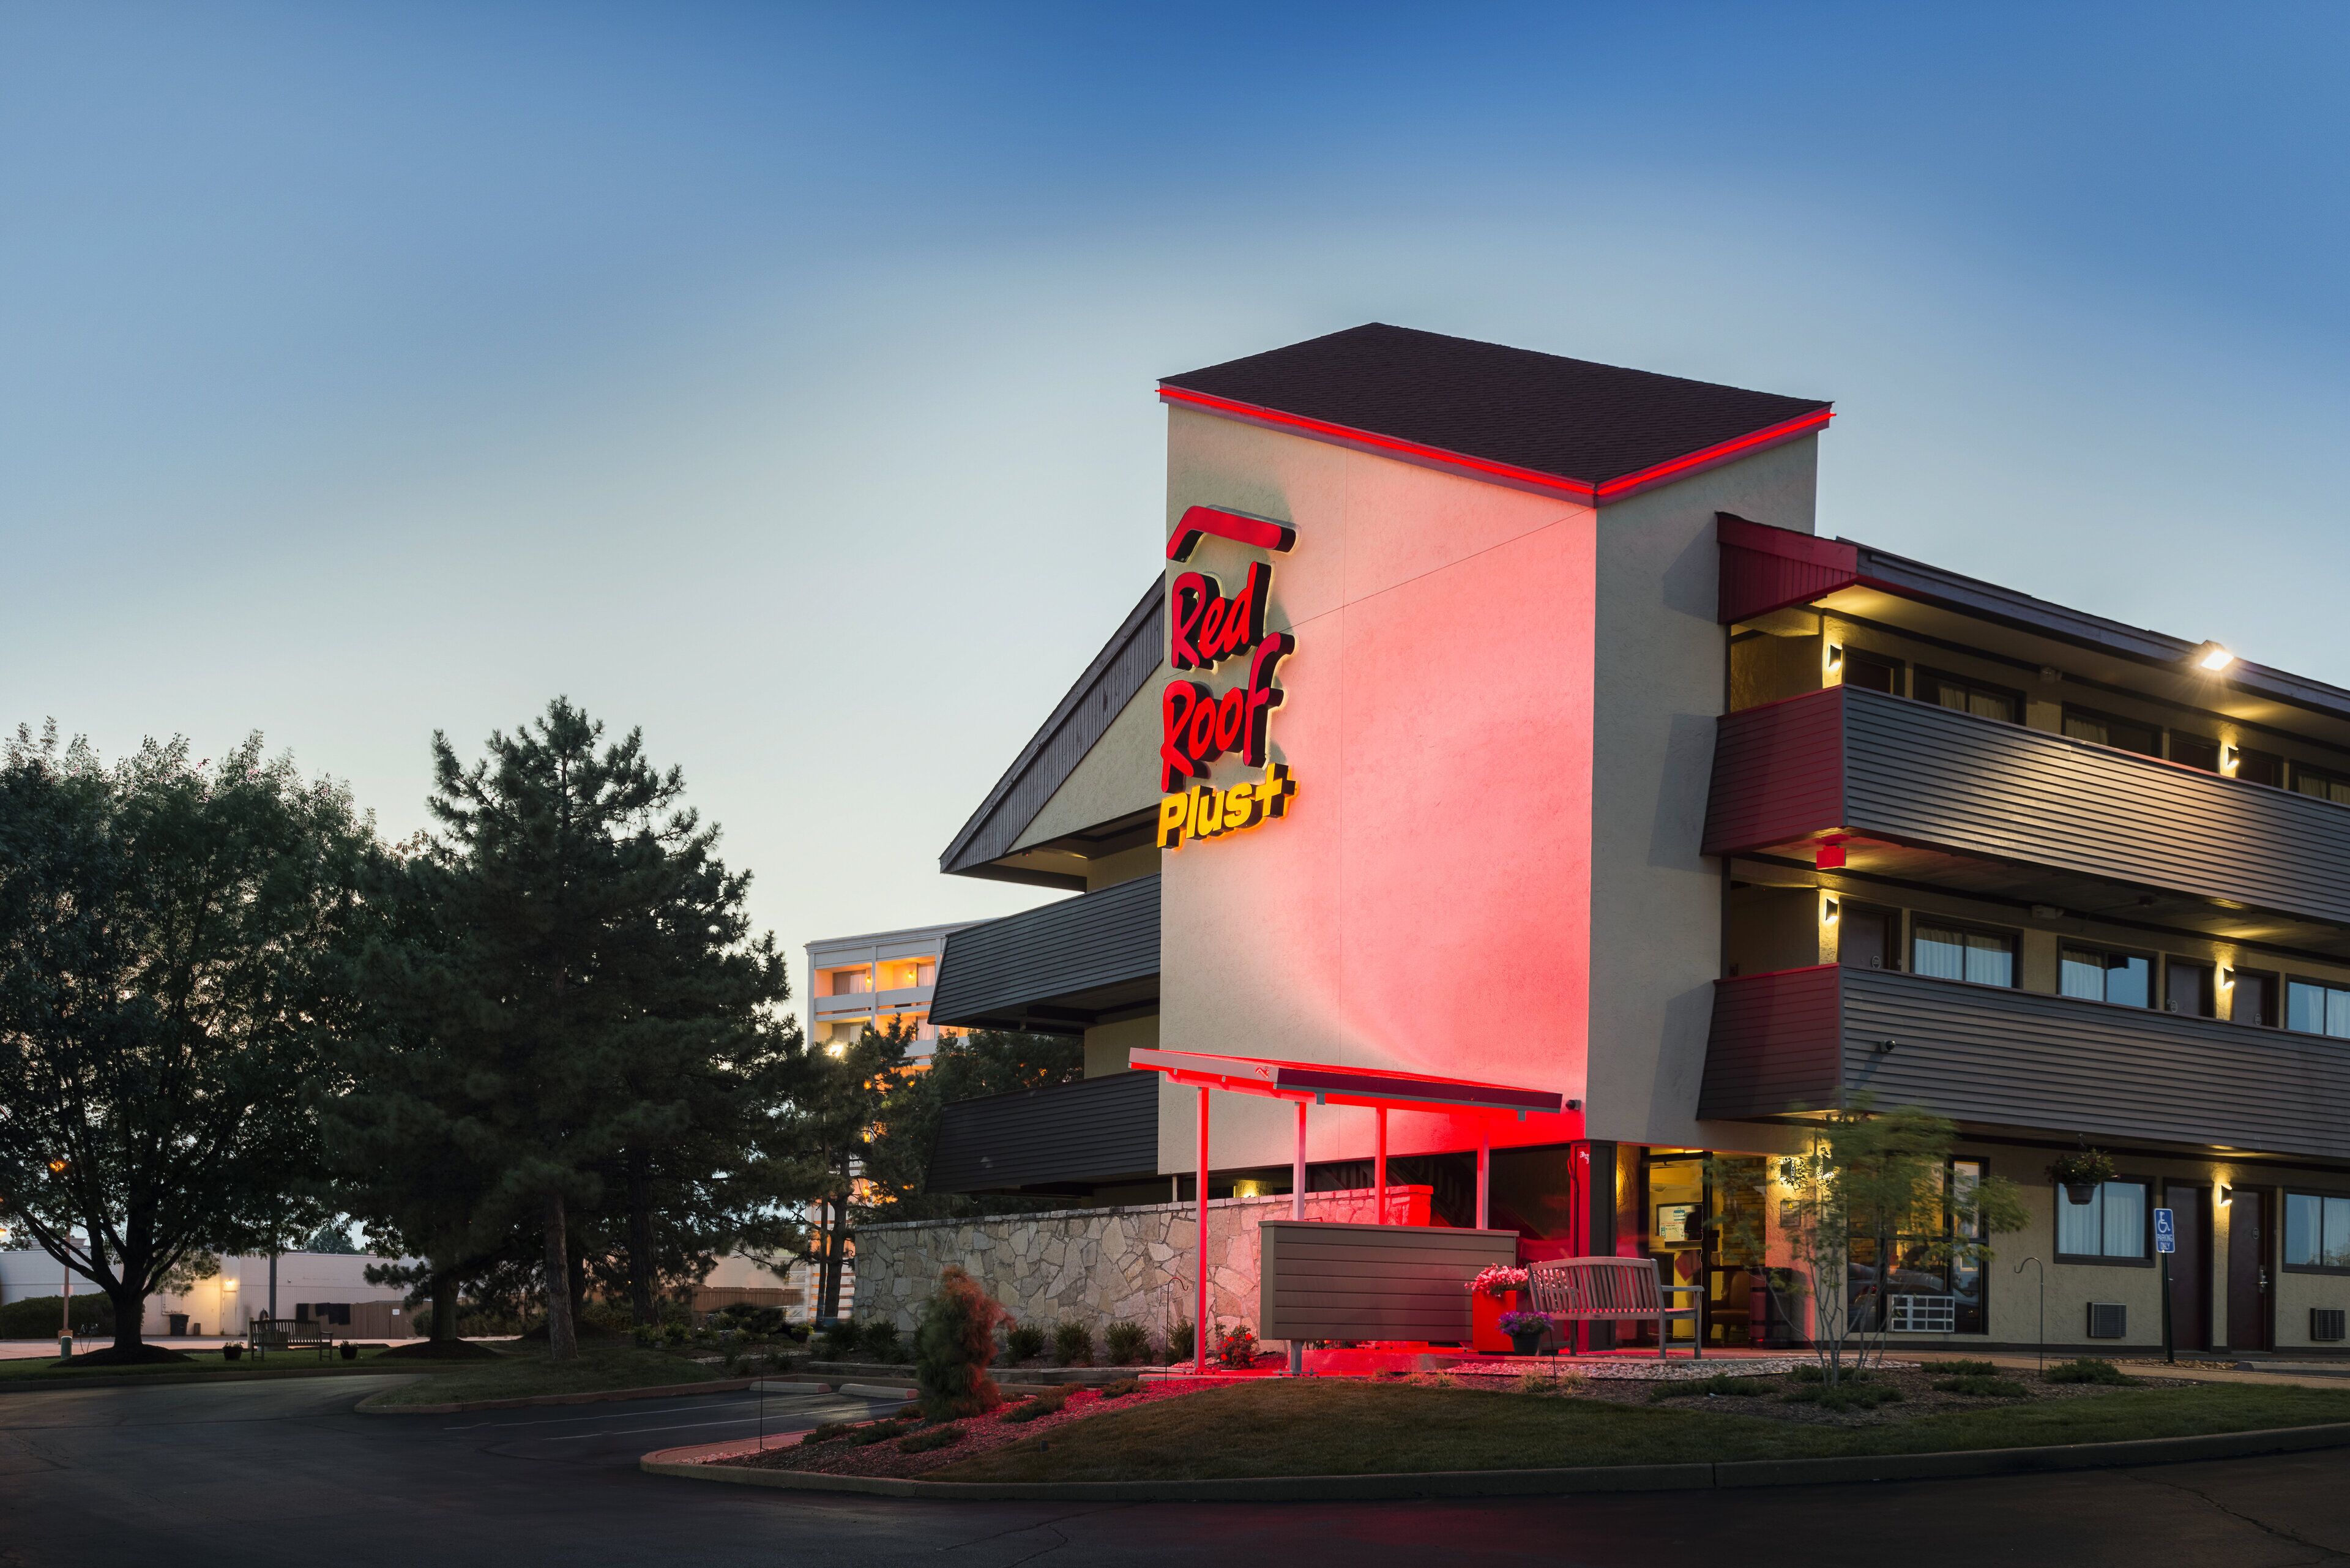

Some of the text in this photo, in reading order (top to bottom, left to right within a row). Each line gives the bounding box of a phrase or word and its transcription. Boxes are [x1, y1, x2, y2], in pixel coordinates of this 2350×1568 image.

[1171, 561, 1271, 670] Red
[1160, 631, 1295, 794] Roof
[1157, 763, 1297, 849] Plus+
[2157, 1234, 2173, 1242] PARKING
